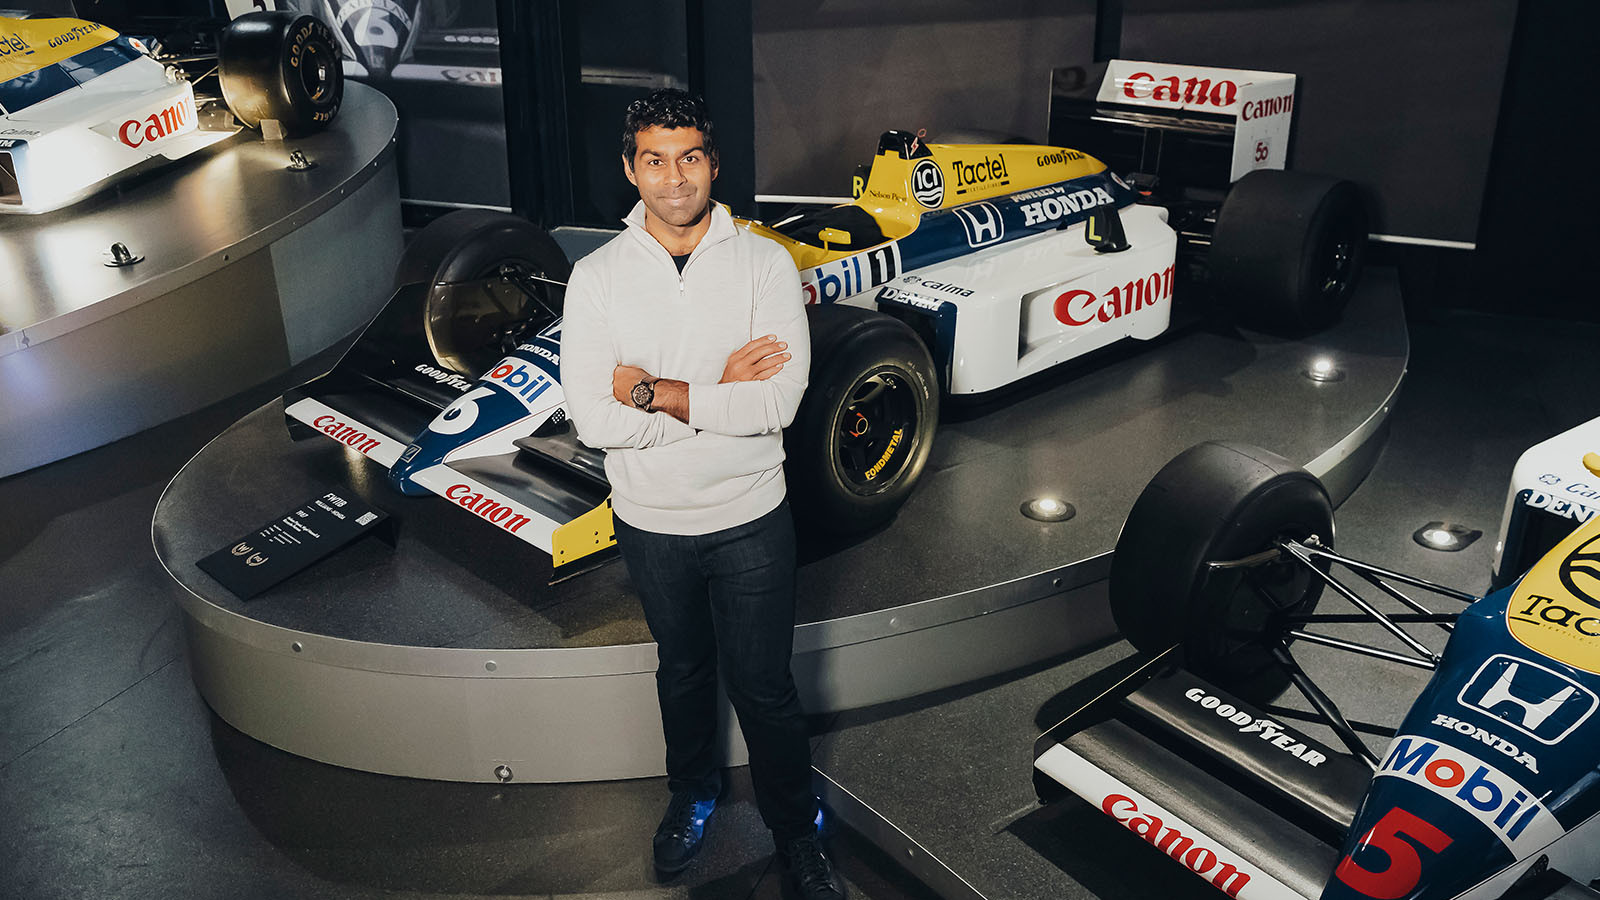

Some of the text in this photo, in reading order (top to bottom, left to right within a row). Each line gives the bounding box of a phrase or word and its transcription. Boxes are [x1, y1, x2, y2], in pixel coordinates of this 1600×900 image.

[0, 33, 31, 57] ctel
[1123, 72, 1238, 107] Cano
[1242, 93, 1293, 121] Canon
[852, 175, 865, 198] R
[916, 167, 938, 190] ICI
[952, 153, 1009, 187] Tactel
[1010, 188, 1055, 203] POWERED
[1020, 187, 1115, 227] HONDA
[1089, 216, 1102, 241] L
[801, 256, 862, 305] obil
[881, 289, 945, 311] DENIM
[922, 280, 974, 297] calma
[1053, 263, 1175, 326] Canon
[415, 364, 472, 392] GOODYEA
[491, 365, 552, 404] obil
[428, 386, 497, 435] 6
[313, 415, 381, 454] Canon
[865, 428, 903, 481] FONDMETAL
[445, 484, 531, 533] Canon
[1526, 489, 1596, 523] DEN
[1520, 594, 1600, 637] Tac
[1185, 688, 1326, 767] GOODYEAR
[1431, 713, 1540, 775] HONDA
[1382, 738, 1541, 842] Mobil
[1102, 793, 1251, 899] Canon
[1335, 806, 1455, 900] 5
